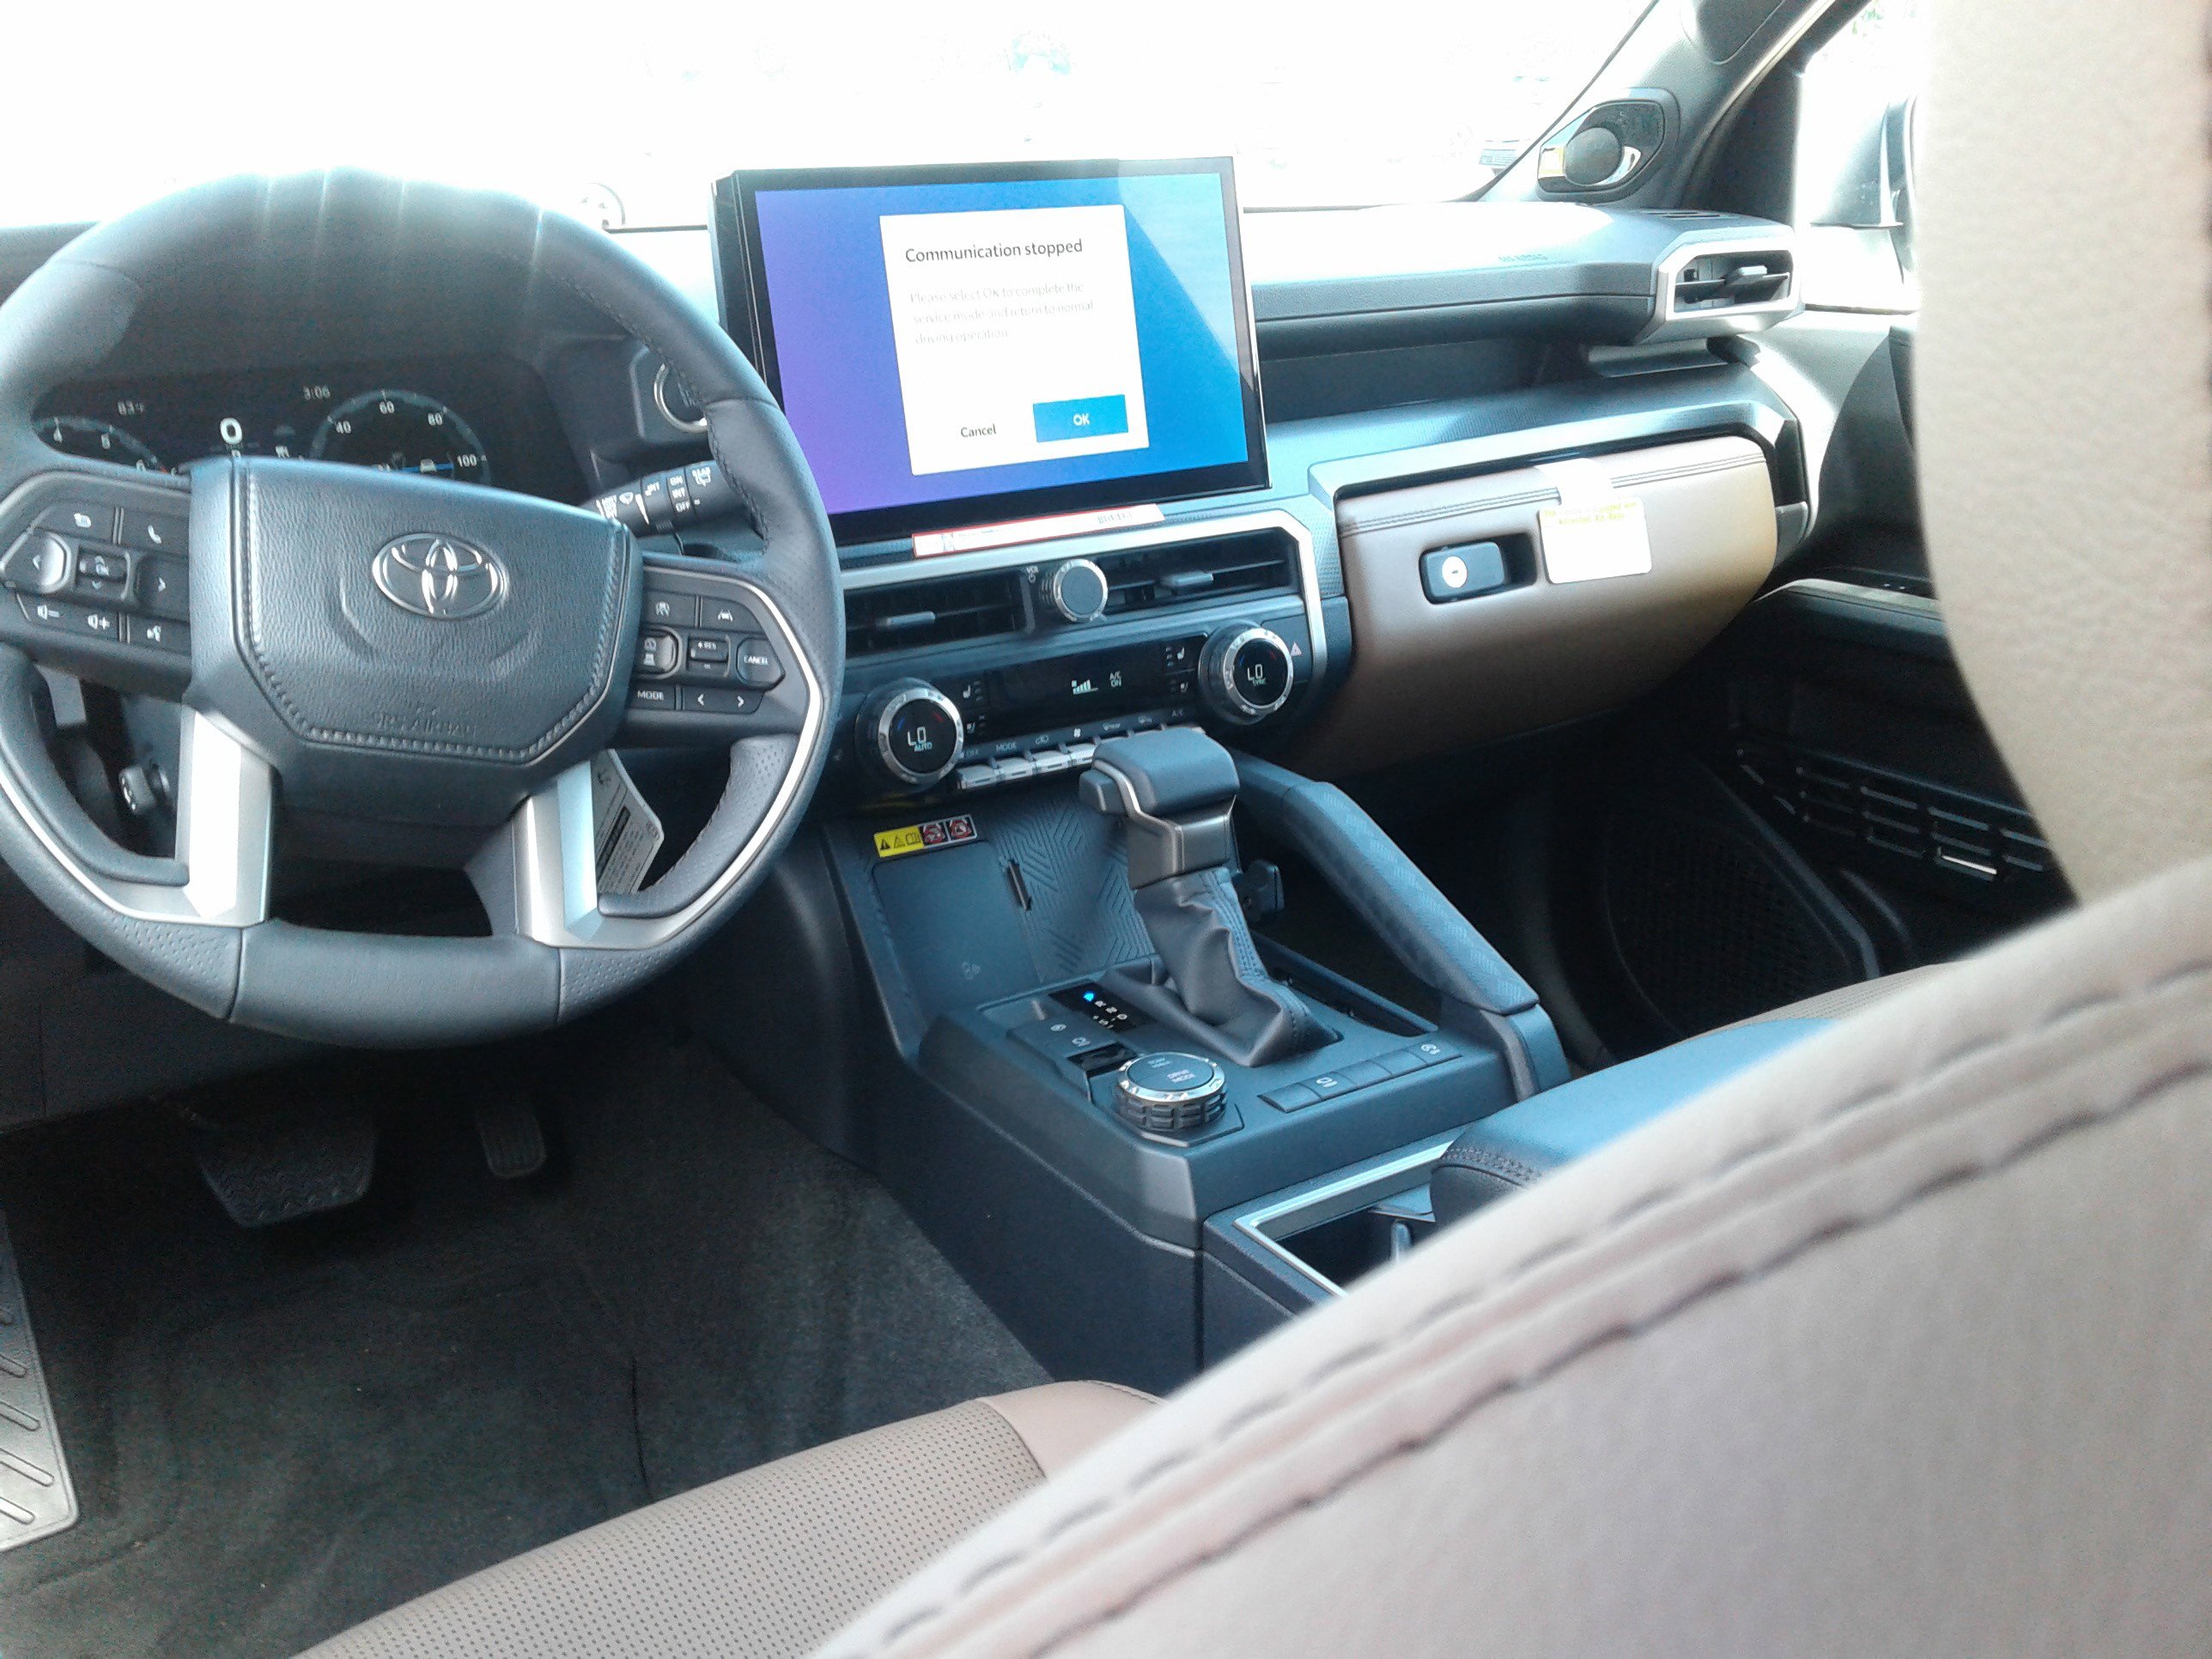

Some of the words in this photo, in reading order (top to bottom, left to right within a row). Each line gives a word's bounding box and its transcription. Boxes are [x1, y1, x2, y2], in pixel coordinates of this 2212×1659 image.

[905, 243, 1022, 263] Communication
[1024, 239, 1083, 258] stopped
[982, 287, 1000, 300] OK
[1002, 287, 1013, 298] to
[1015, 283, 1065, 299] complete
[1066, 282, 1084, 293] the
[1044, 304, 1055, 315] to
[1058, 300, 1095, 314] normal
[336, 420, 352, 434] 40
[1073, 413, 1091, 427] OK
[220, 417, 244, 446] 0
[960, 423, 997, 438] Cancel
[457, 453, 477, 468] 100
[637, 690, 665, 702] MODE
